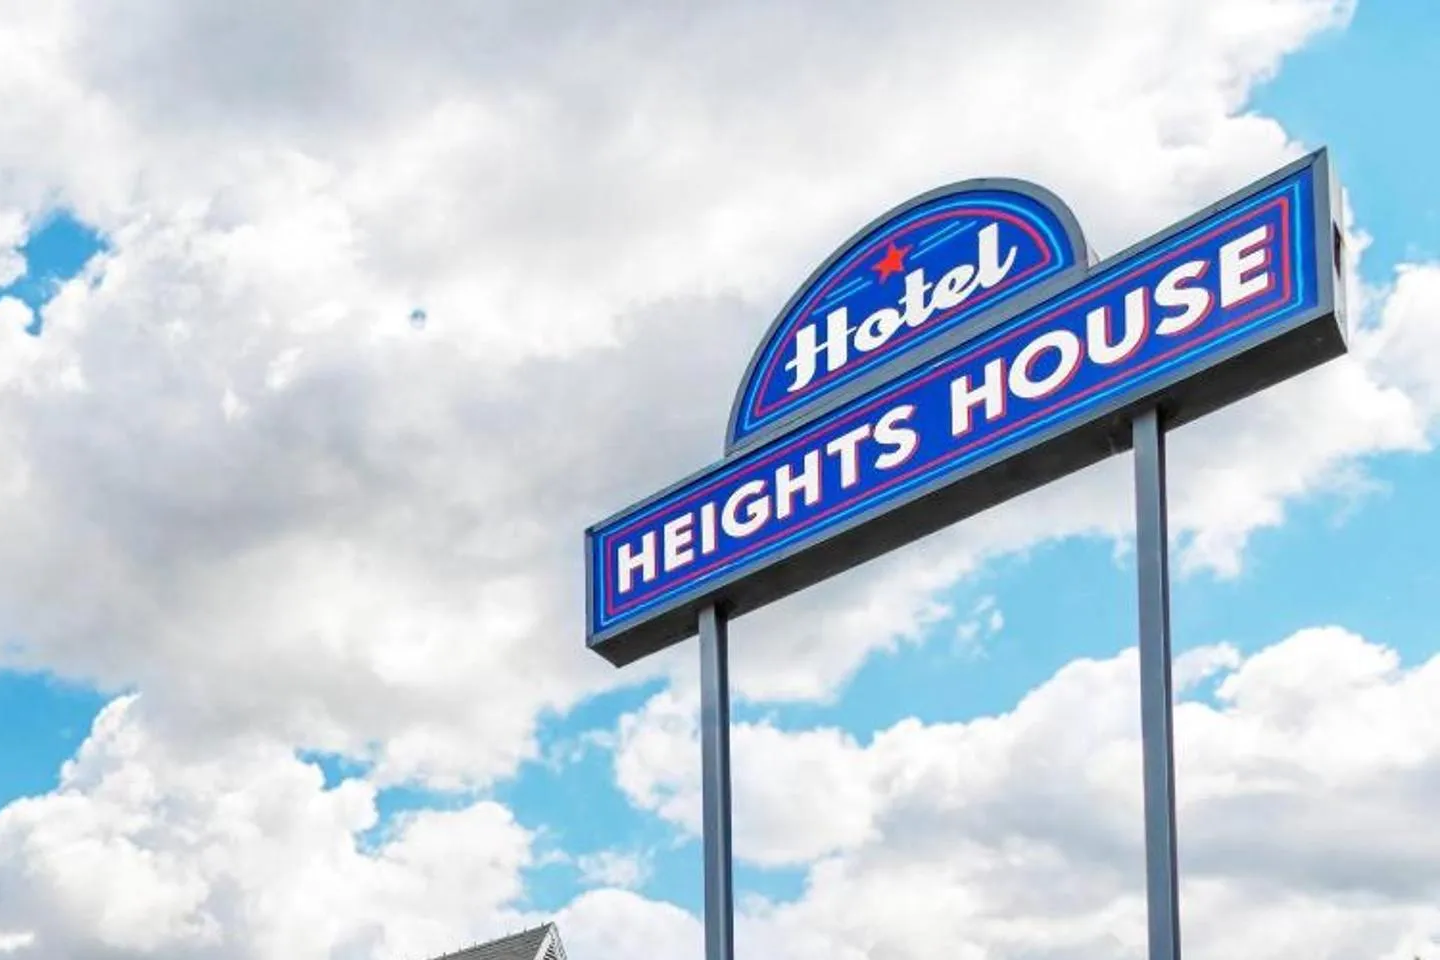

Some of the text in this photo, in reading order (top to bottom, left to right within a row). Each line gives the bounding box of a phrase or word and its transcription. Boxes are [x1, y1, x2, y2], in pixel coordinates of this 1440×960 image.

[617, 223, 1273, 595] HEIGHTS HOUSE
[785, 222, 1018, 392] Hotel
